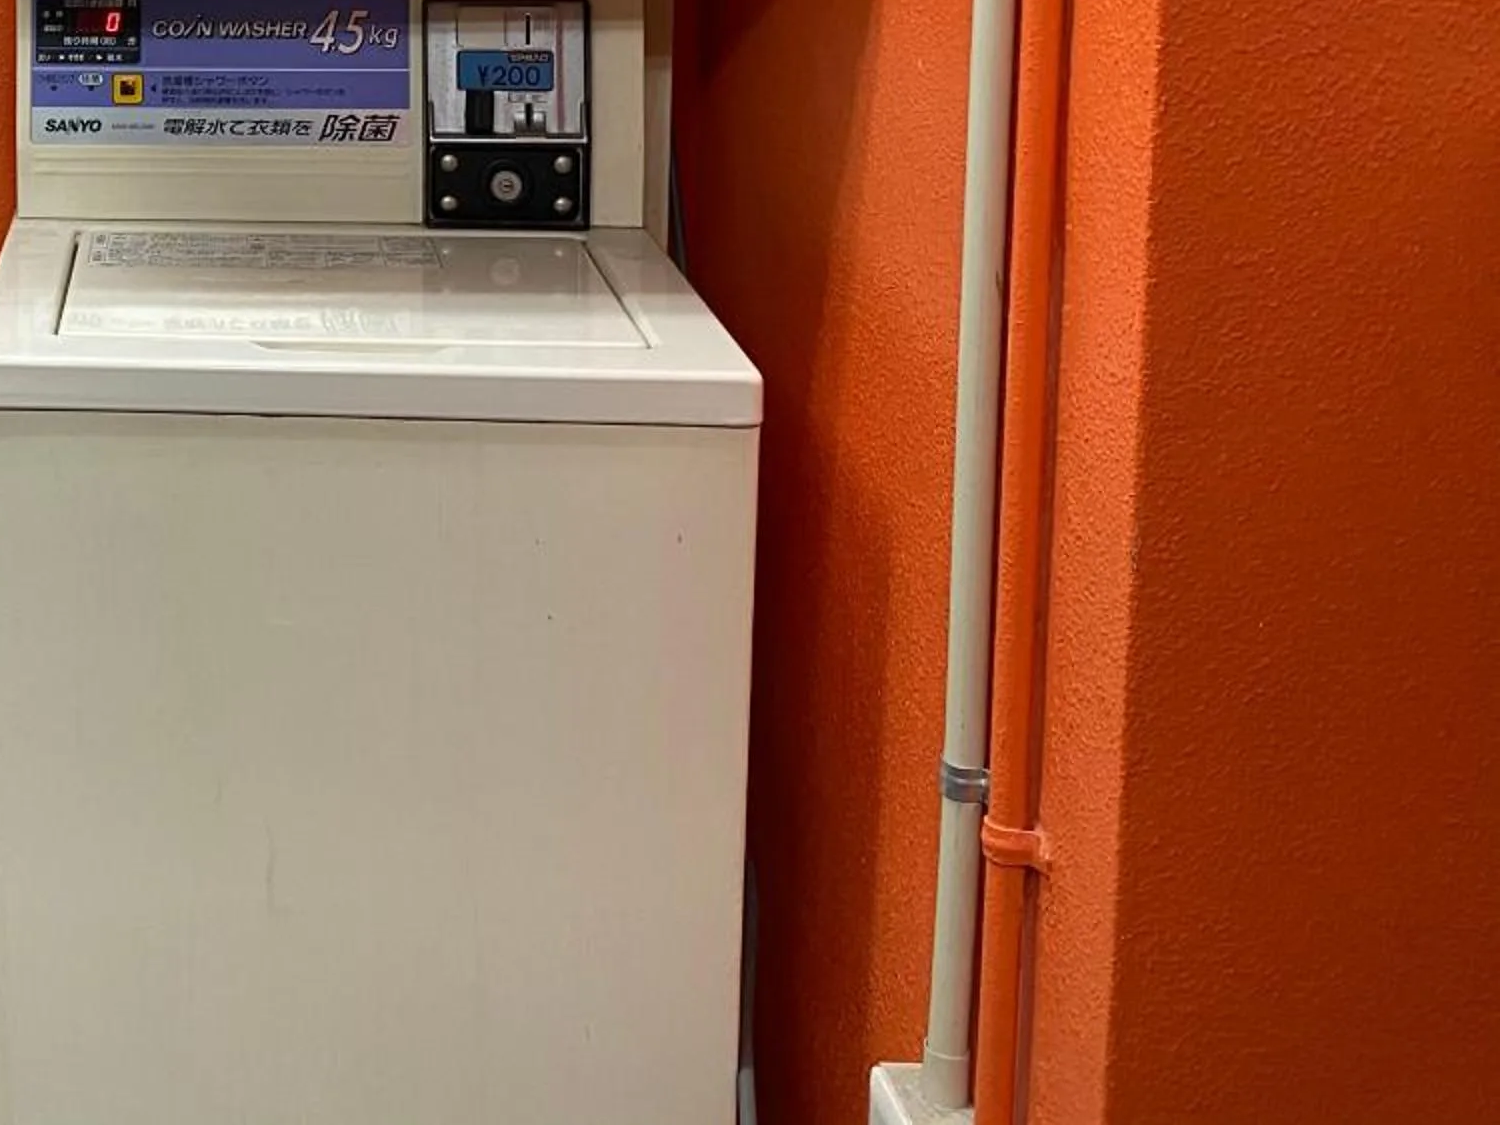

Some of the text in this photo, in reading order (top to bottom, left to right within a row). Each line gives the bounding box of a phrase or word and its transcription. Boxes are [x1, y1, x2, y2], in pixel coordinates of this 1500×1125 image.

[106, 12, 121, 32] 0
[152, 15, 212, 38] COIN
[219, 21, 308, 39] WASHER
[477, 65, 541, 87] ¥200
[45, 118, 102, 133] SANYO
[163, 114, 401, 142] 電解水で衣類を 除菌
